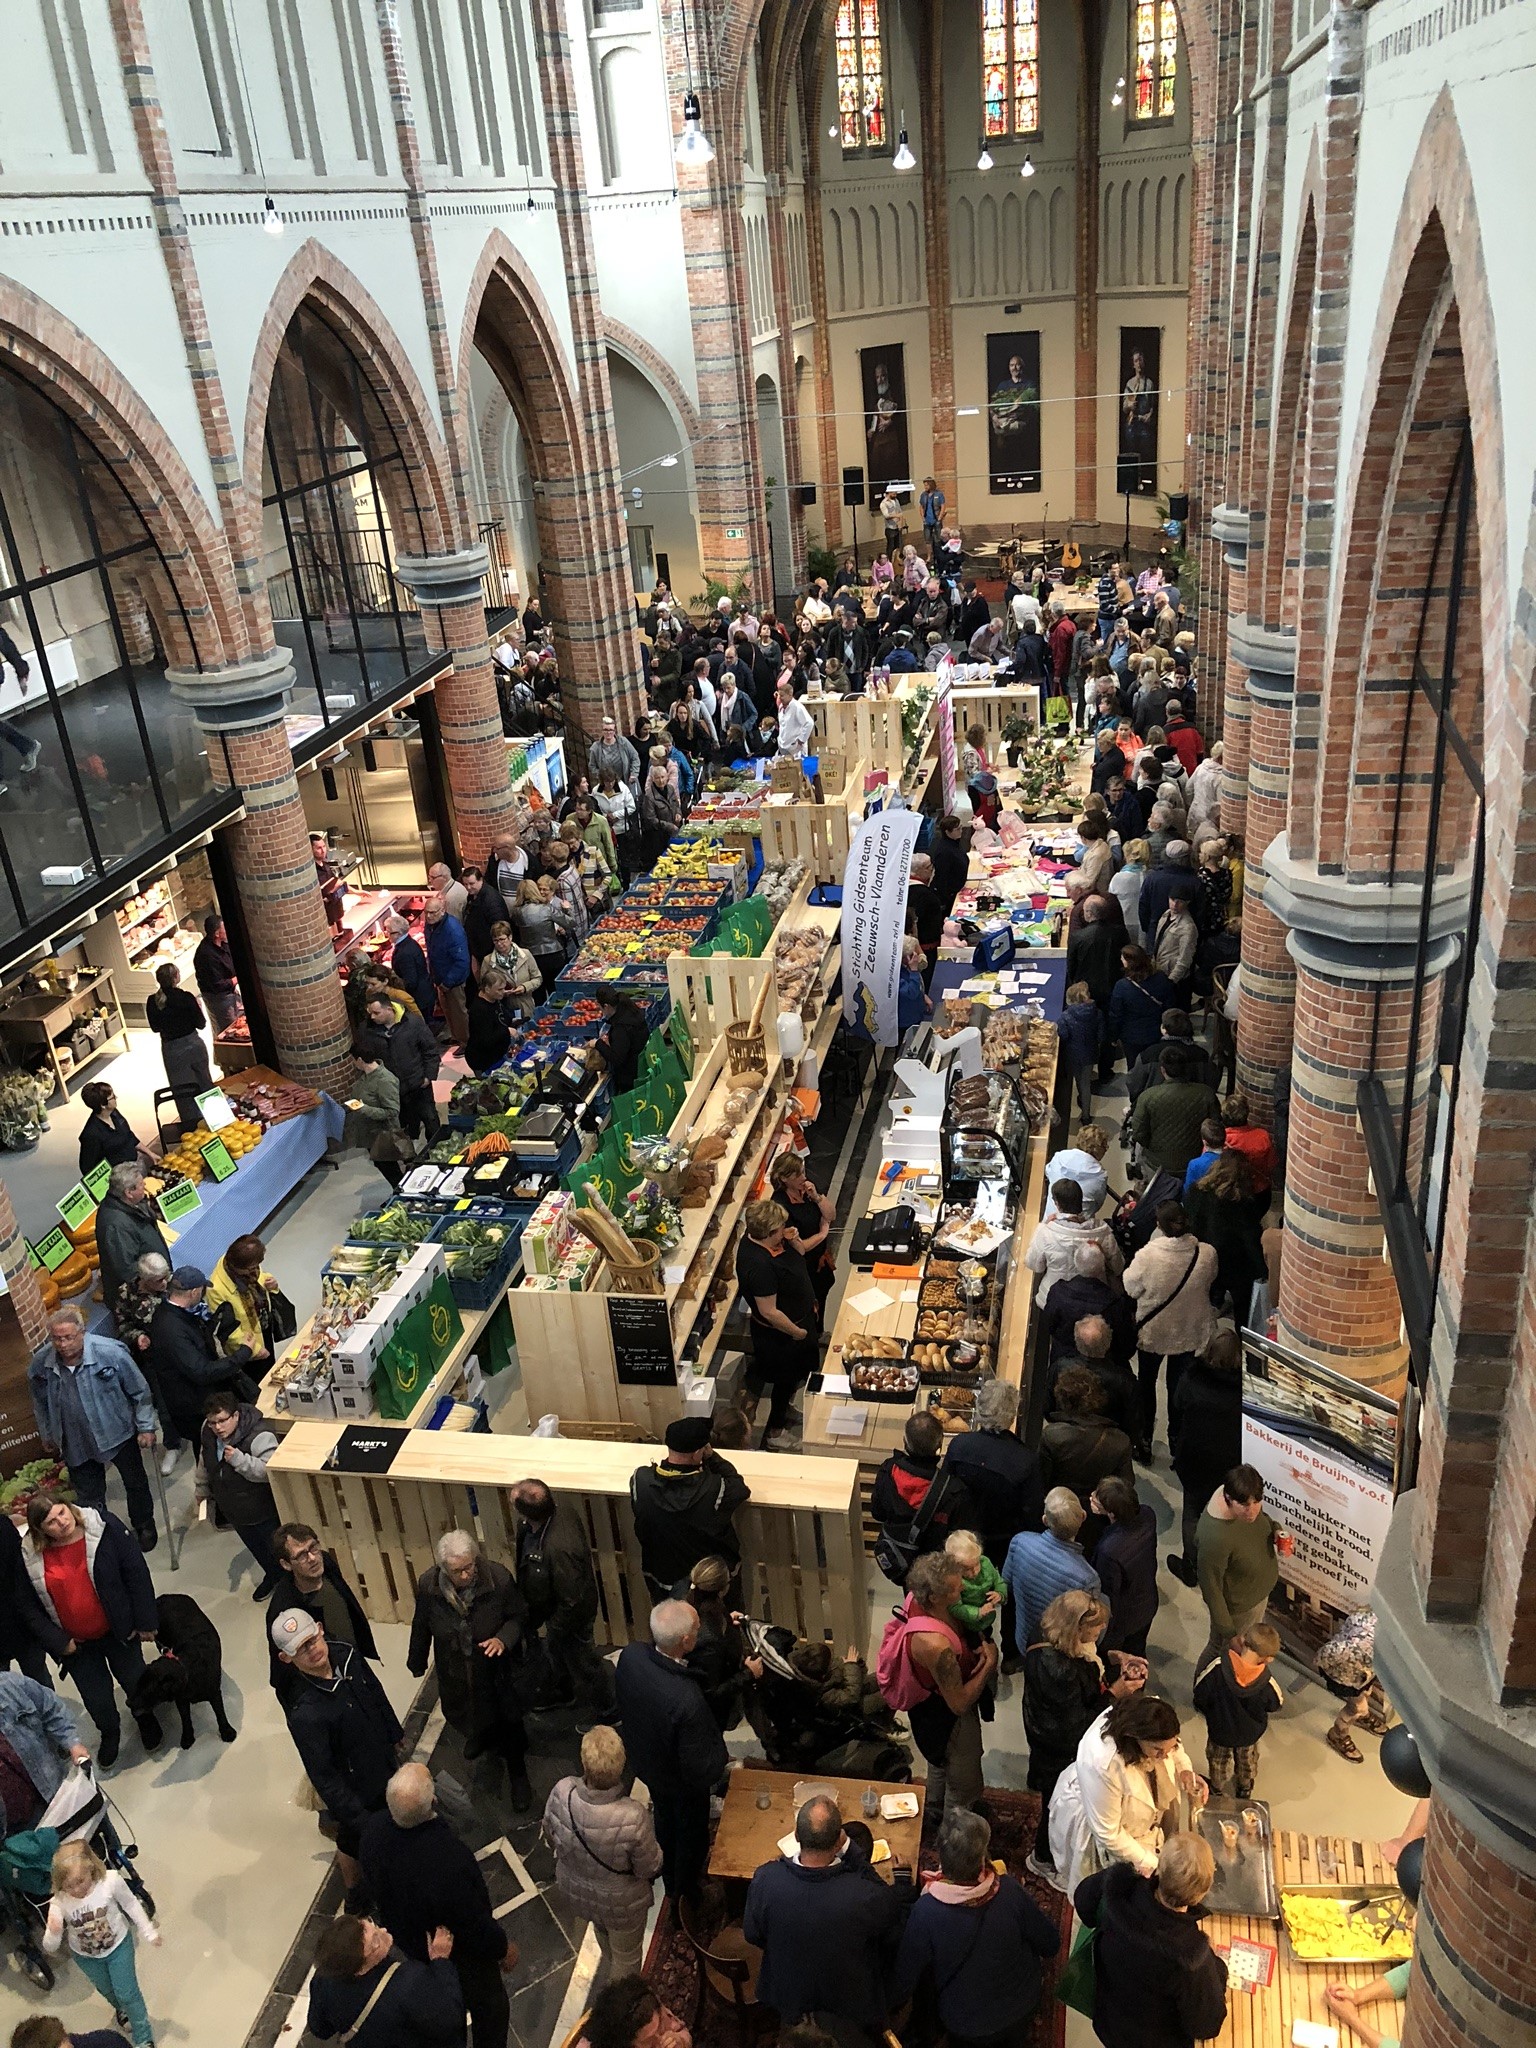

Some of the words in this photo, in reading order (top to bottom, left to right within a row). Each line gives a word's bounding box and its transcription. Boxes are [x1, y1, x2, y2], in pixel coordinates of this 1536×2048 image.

[853, 835, 873, 913] Gidsenteam
[898, 838, 911, 887] 06-12711700
[864, 824, 891, 973] Zeeuwsch-Vlaanderen
[896, 887, 905, 905] telnr
[852, 916, 866, 979] Stichting
[0, 1431, 40, 1450] aliteiten
[1245, 1422, 1293, 1455] Bakkerij
[1295, 1449, 1310, 1463] de
[1312, 1457, 1356, 1488] Bruijne
[1358, 1484, 1388, 1505] v.o.f.
[1263, 1481, 1302, 1506] Warme
[1304, 1500, 1347, 1530] bakker
[1348, 1527, 1372, 1546] met
[1263, 1495, 1333, 1538] mbachtelijk
[1336, 1532, 1374, 1562] brood,
[1284, 1517, 1320, 1544] iedere
[1322, 1540, 1345, 1559] dag
[1309, 1559, 1342, 1582] proef
[1343, 1576, 1358, 1591] je!
[1311, 1549, 1369, 1585] gebakken
